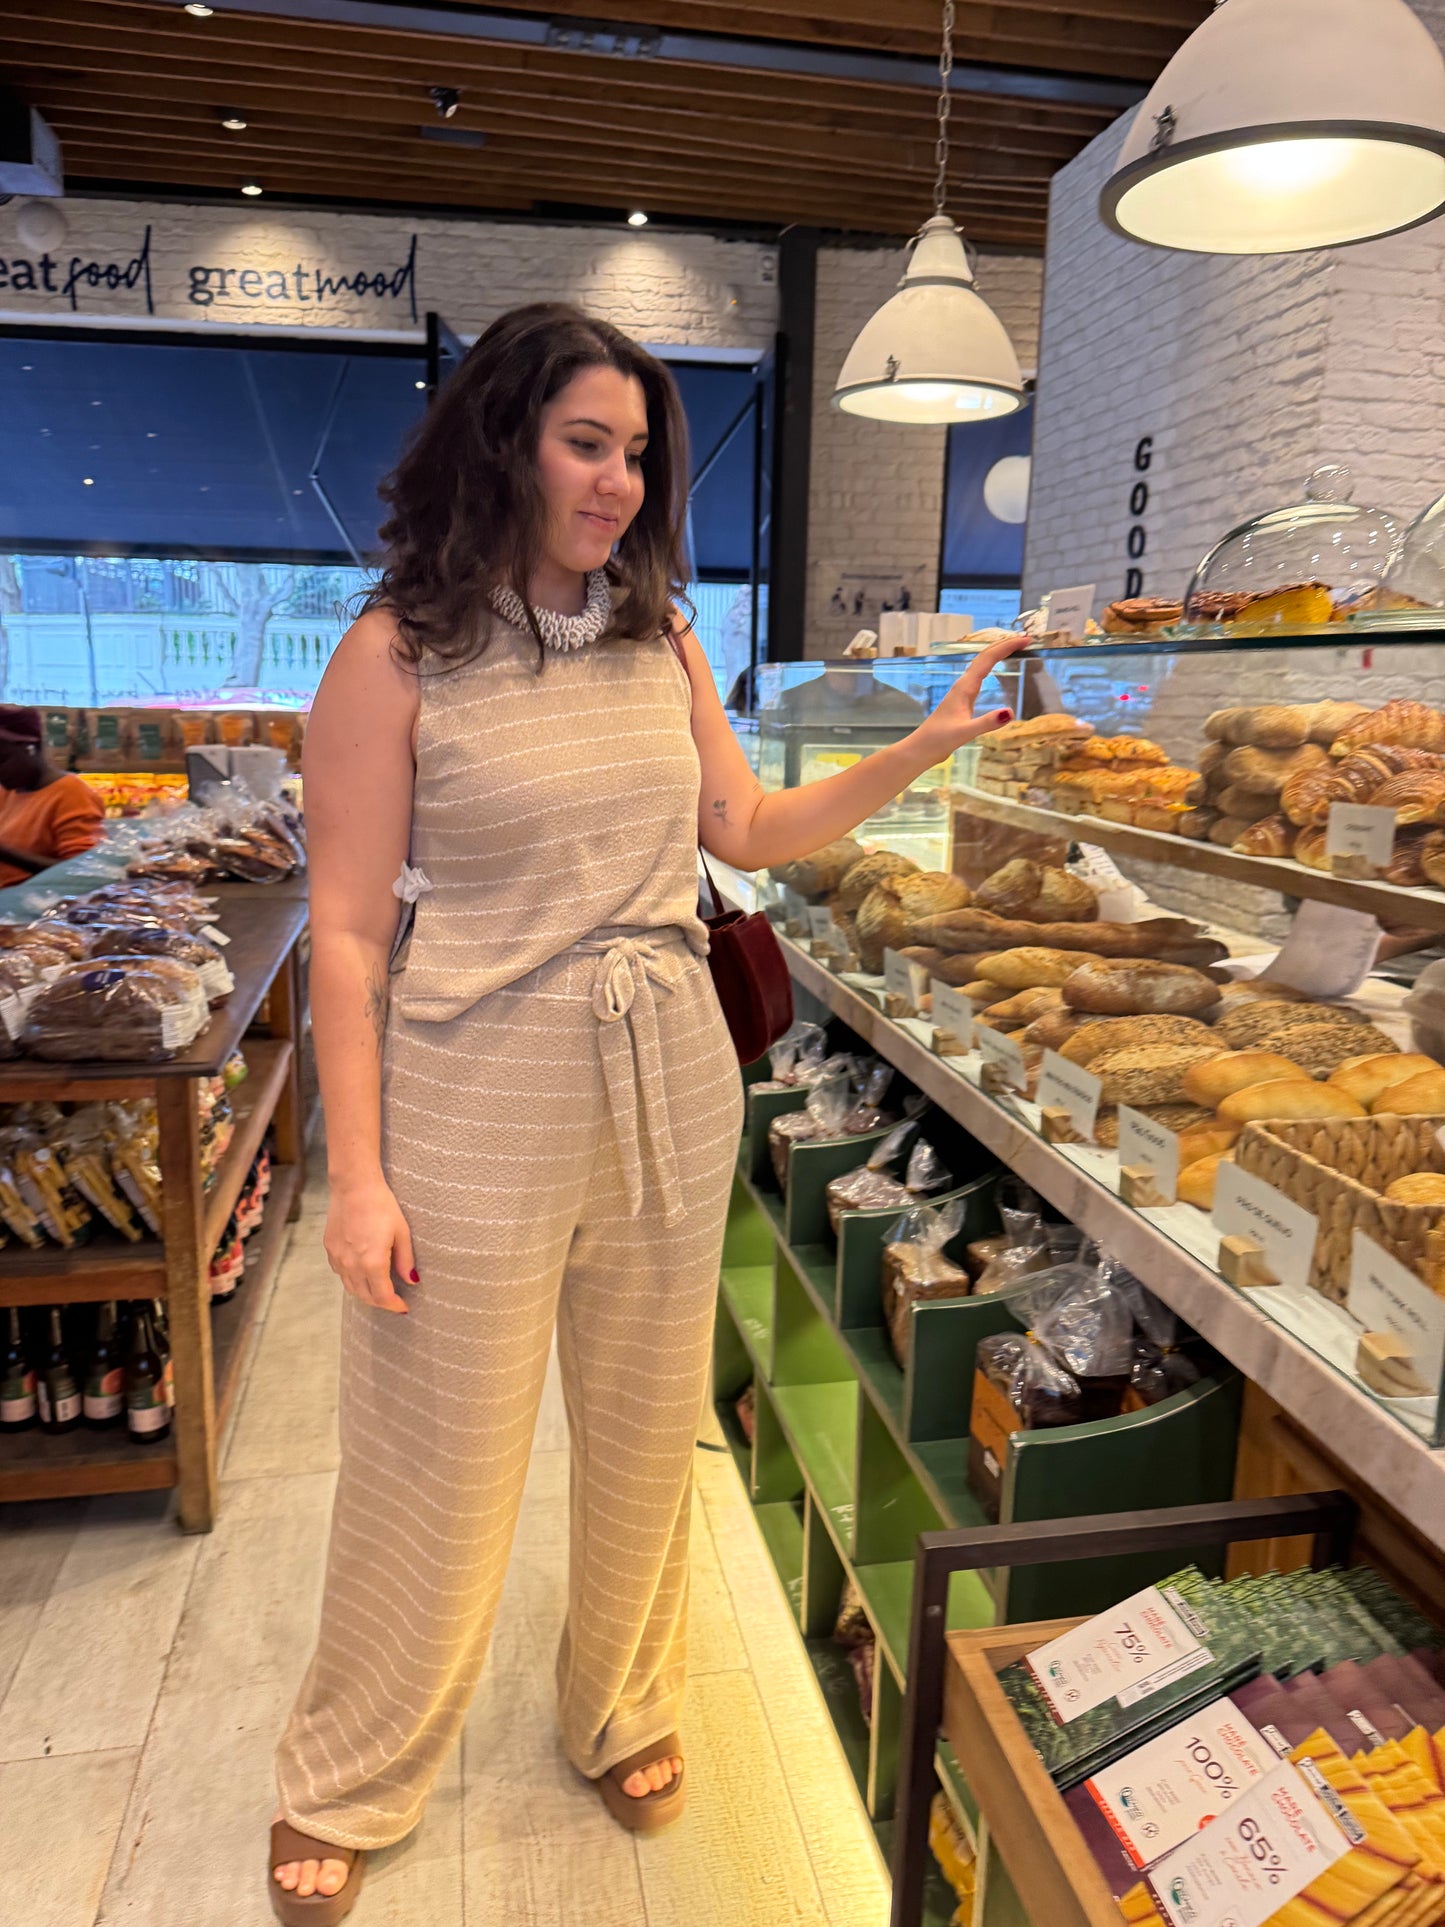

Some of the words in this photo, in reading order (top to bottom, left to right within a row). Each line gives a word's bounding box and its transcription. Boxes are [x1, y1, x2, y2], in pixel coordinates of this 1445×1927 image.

[1124, 436, 1153, 600] GOOD
[1113, 1622, 1152, 1664] 75%
[1184, 1736, 1241, 1799] 100%
[1238, 1816, 1289, 1885] 65%
